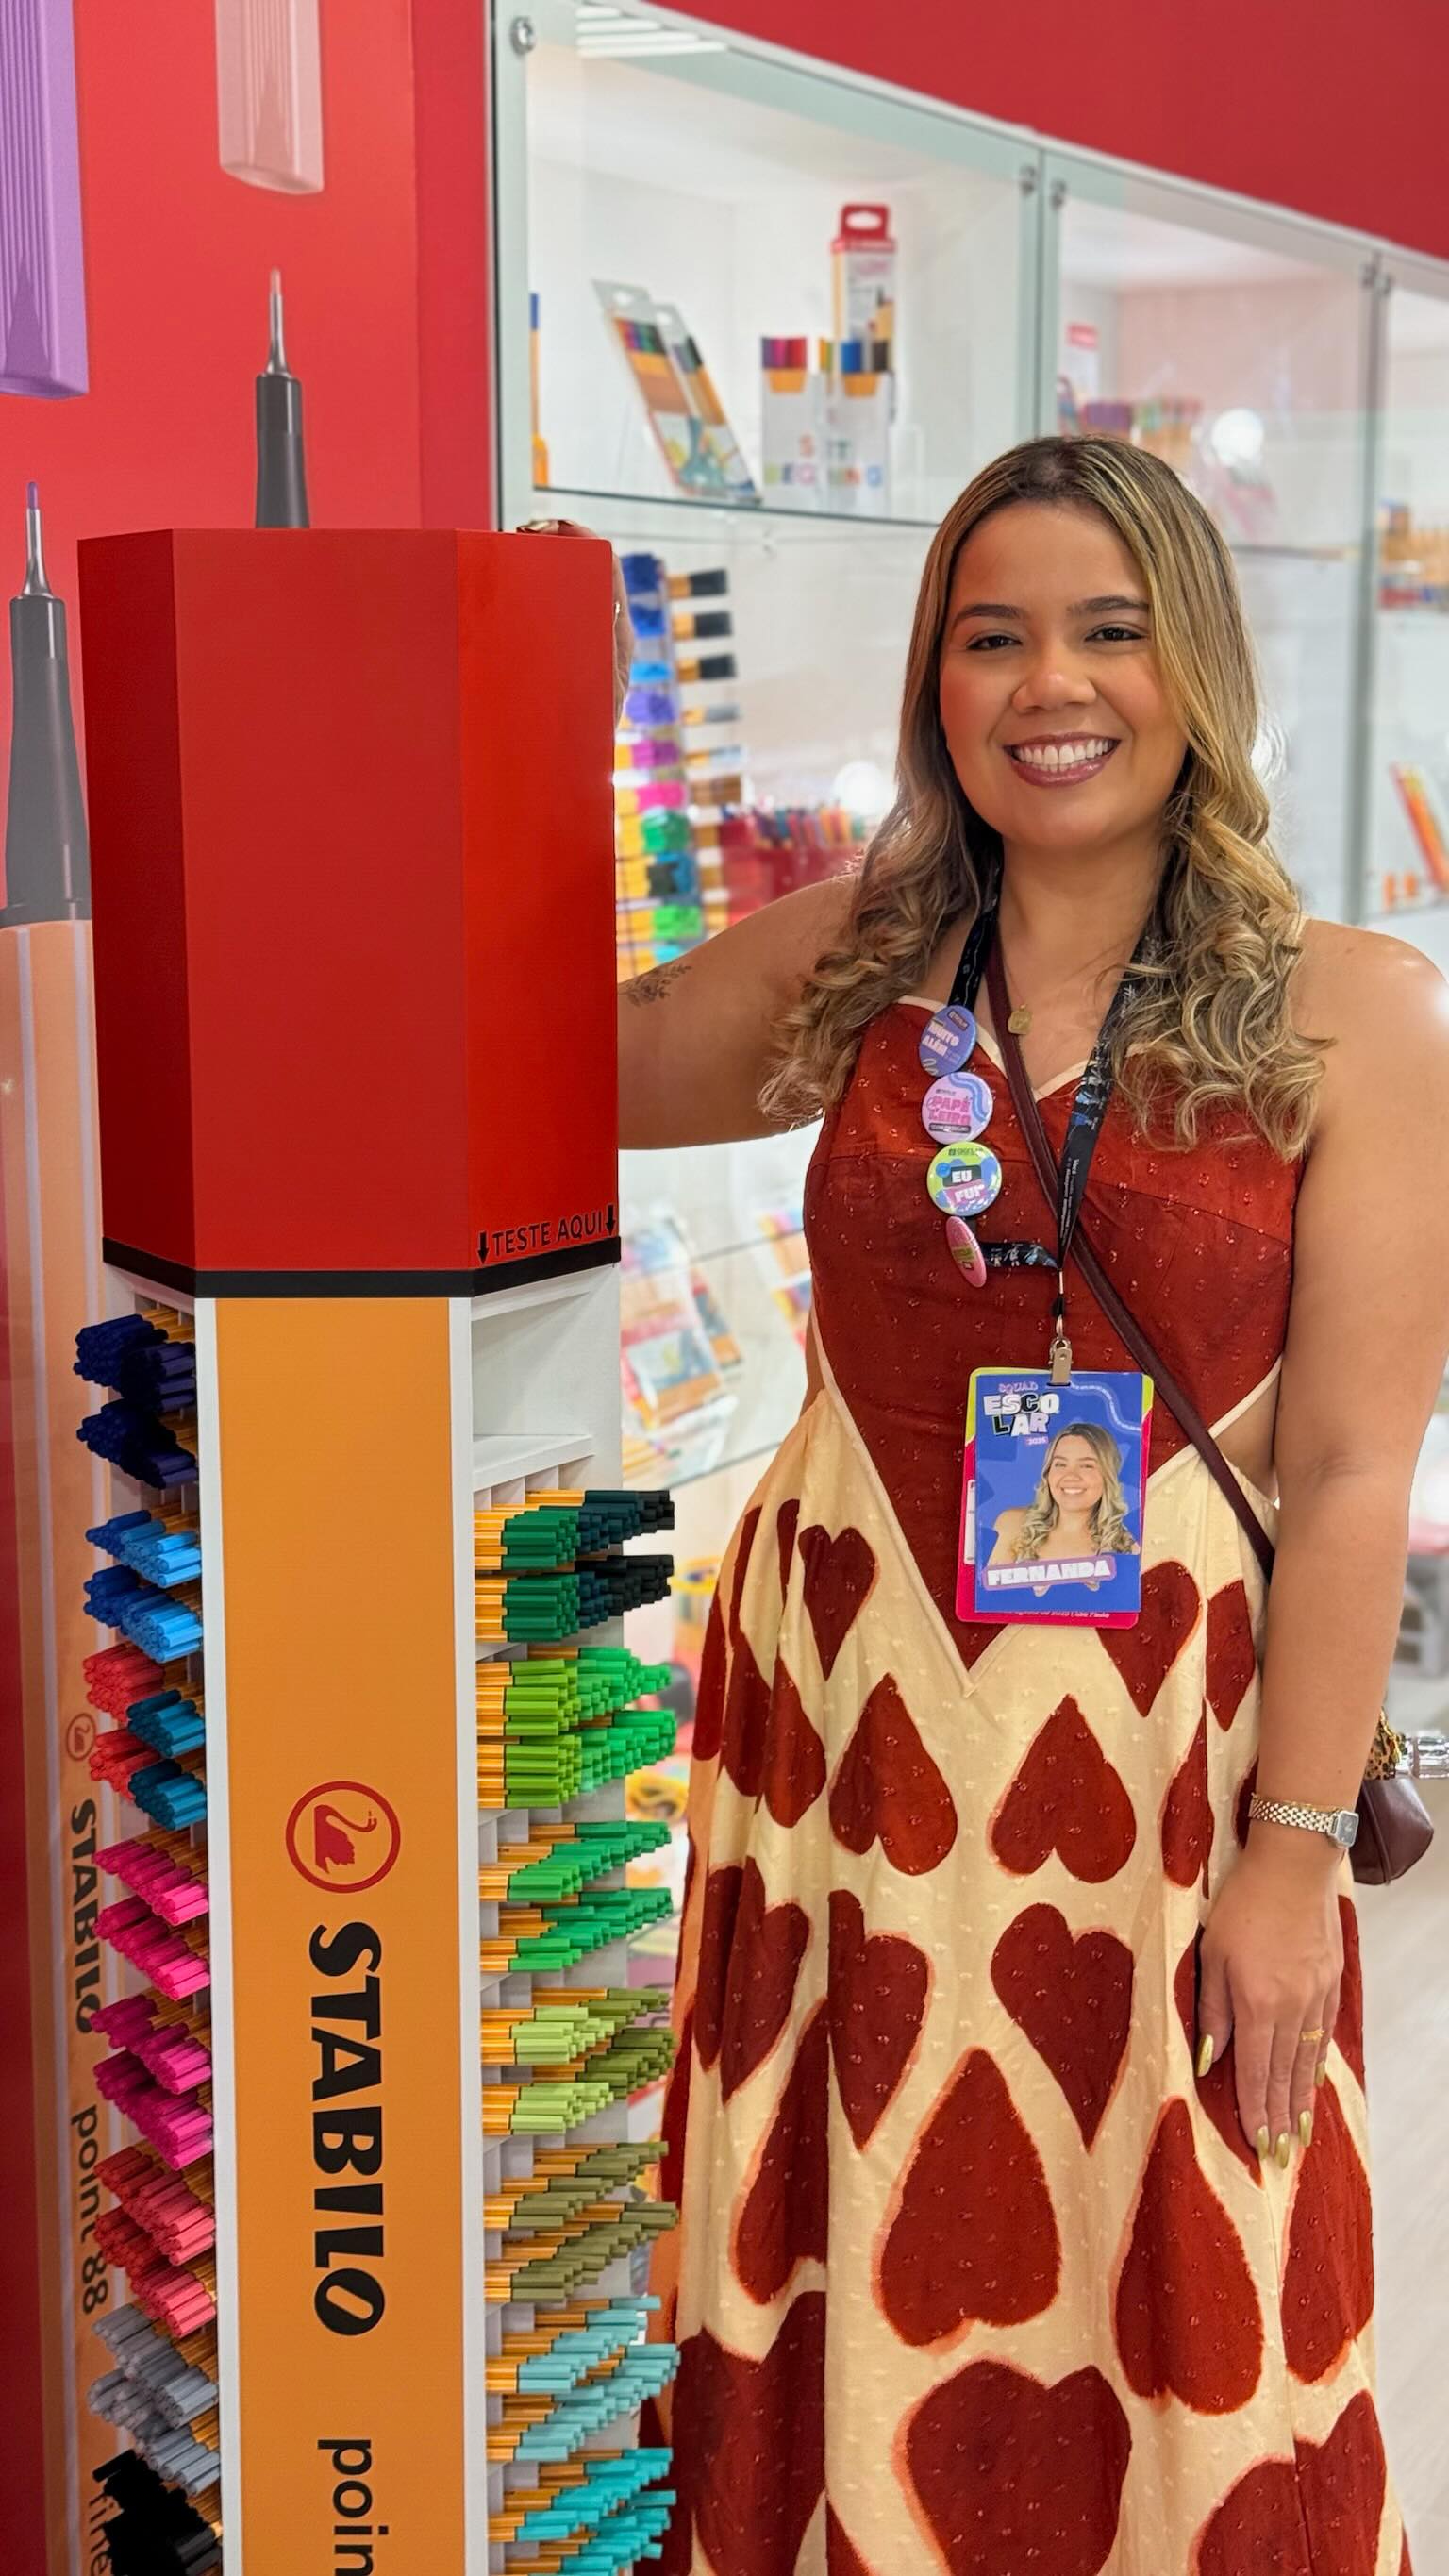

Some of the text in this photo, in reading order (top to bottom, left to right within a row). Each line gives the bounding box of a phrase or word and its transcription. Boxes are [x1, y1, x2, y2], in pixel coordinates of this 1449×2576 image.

[951, 1169, 973, 1184] EU
[491, 1210, 602, 1256] TESTE AQUI
[998, 1380, 1039, 1395] SQUAD
[983, 1392, 1060, 1415] ESCO
[991, 1414, 1050, 1437] LAR
[987, 1559, 1112, 1586] FERNANDA
[71, 1798, 102, 2034] STABILO
[308, 1921, 389, 2576] STABILO poin
[82, 2250, 109, 2315] 88
